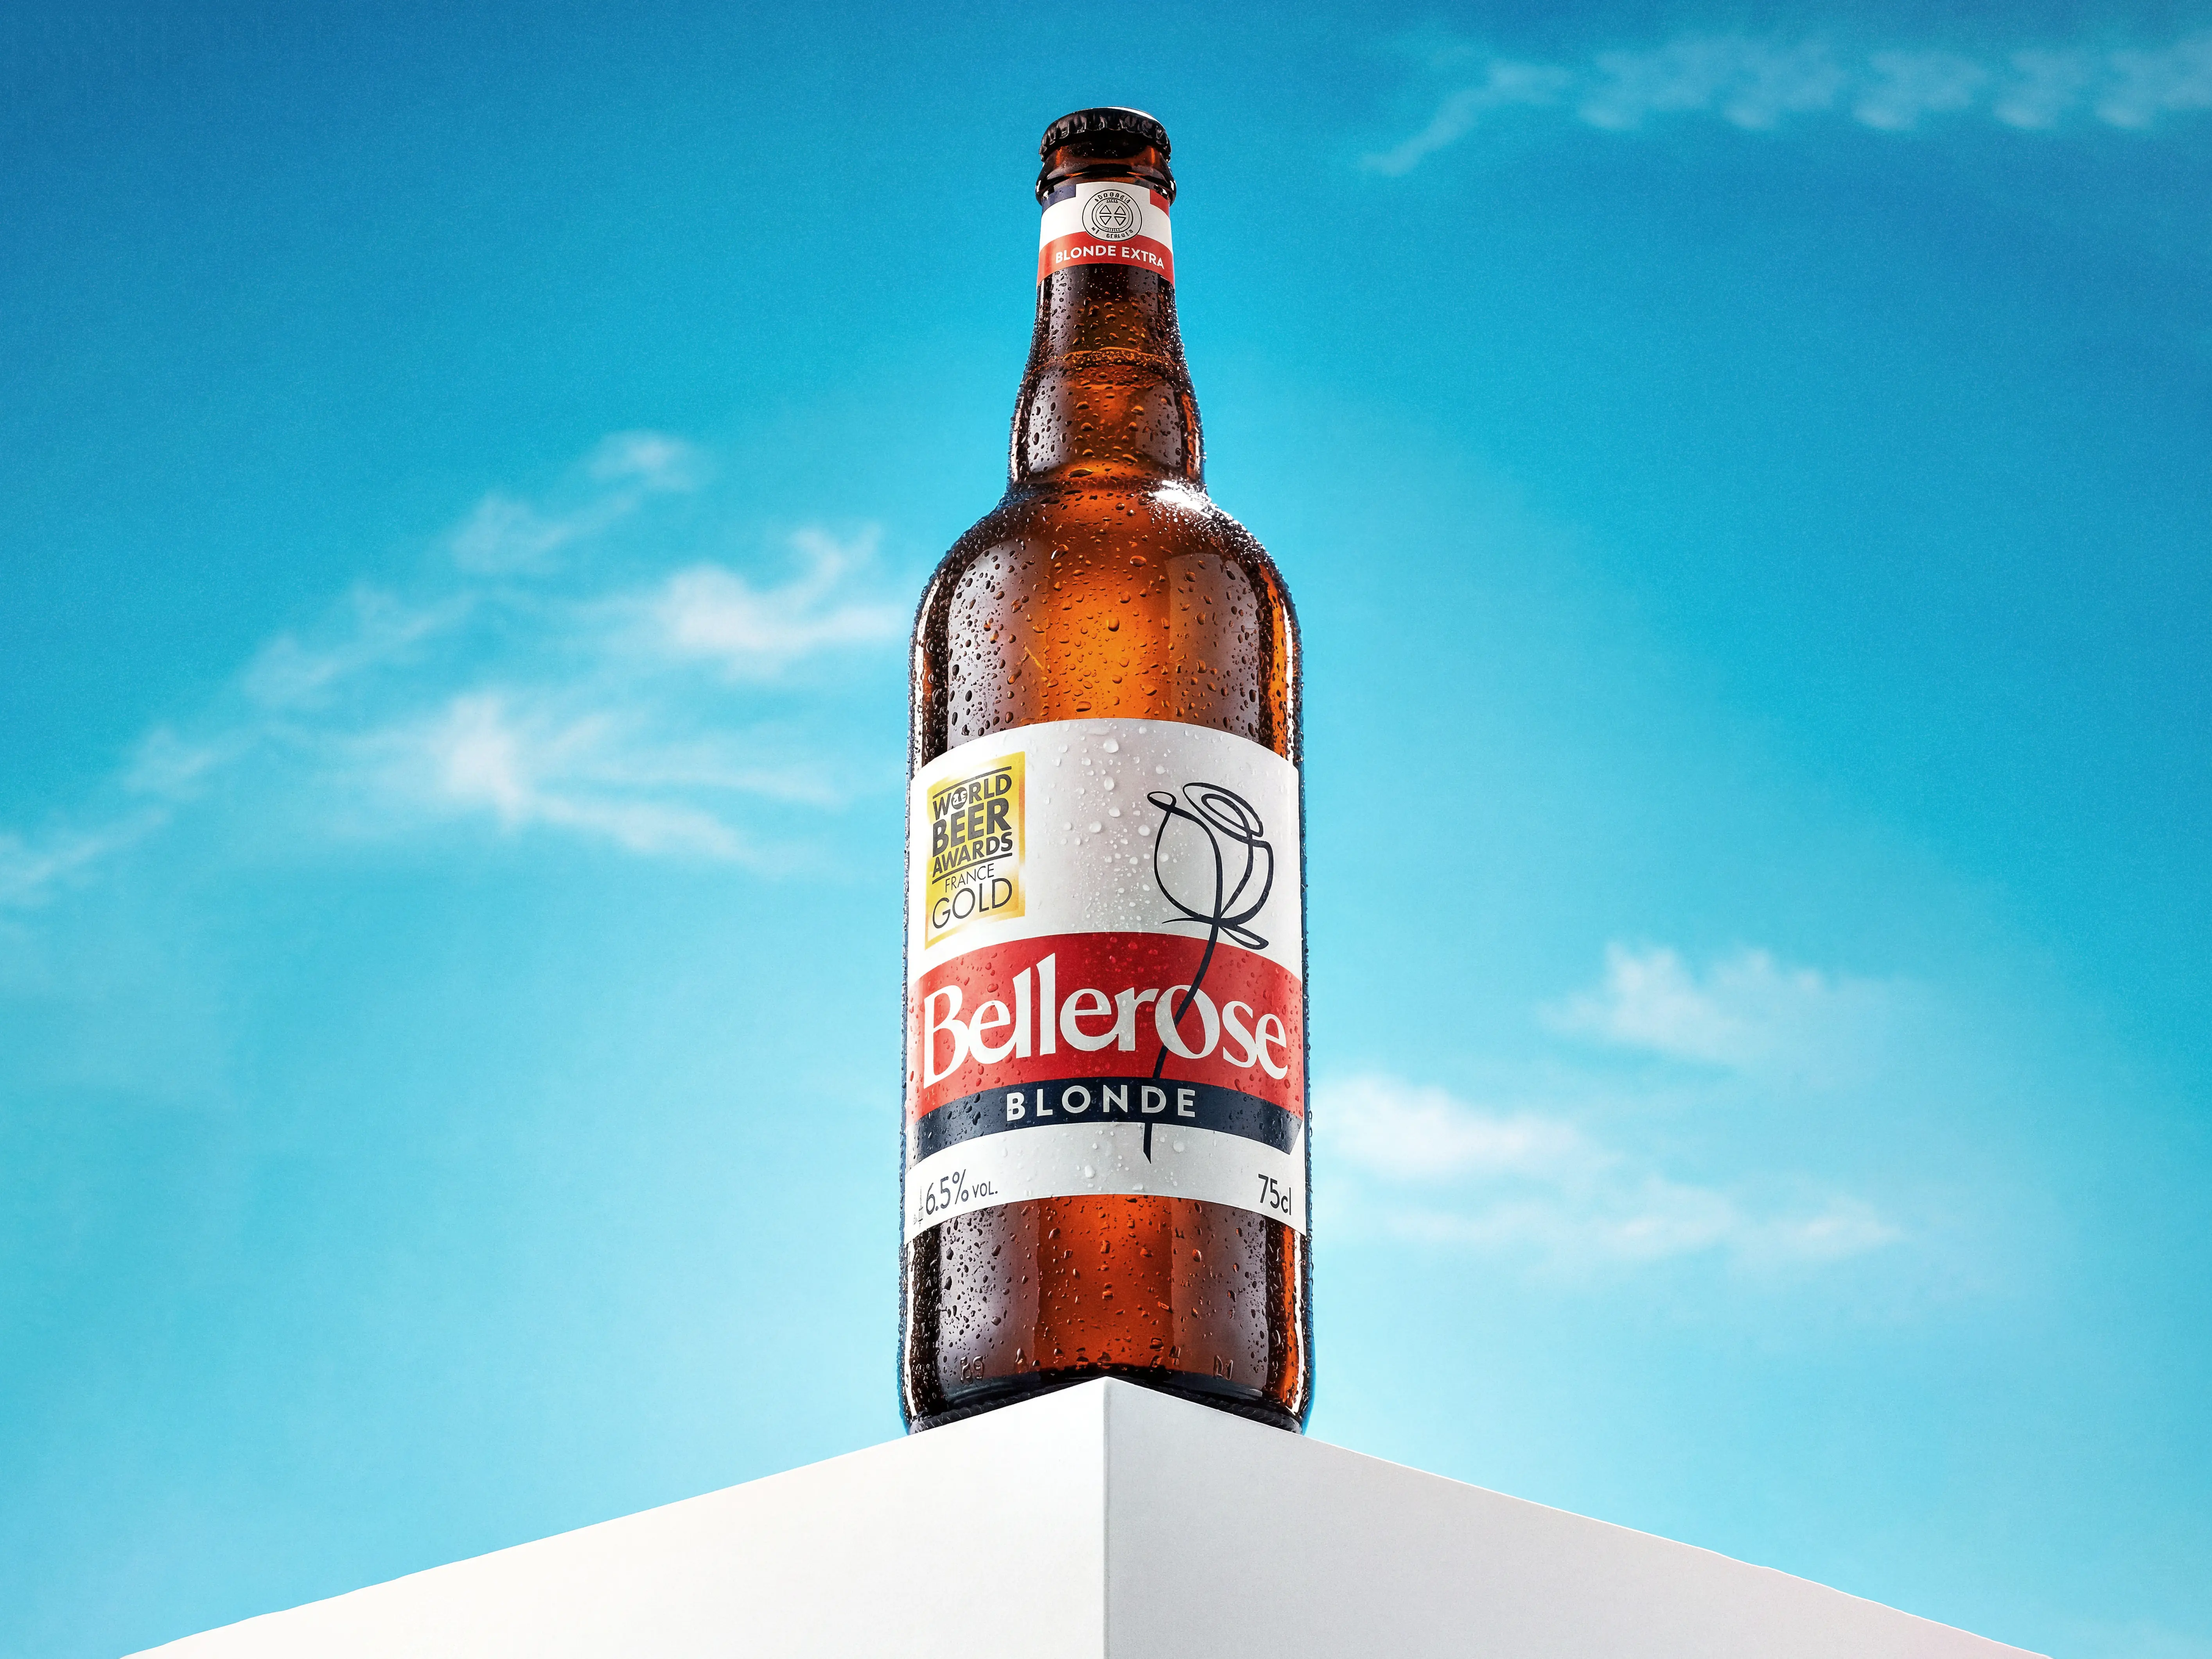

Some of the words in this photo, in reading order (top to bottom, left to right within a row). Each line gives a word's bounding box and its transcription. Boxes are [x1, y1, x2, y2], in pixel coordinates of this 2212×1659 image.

[1056, 245, 1117, 264] BLONDE
[1121, 247, 1165, 270] EXTRA
[932, 774, 1012, 821] WORLD
[932, 798, 1012, 857] BEER
[932, 831, 1013, 878] AWARDS
[945, 863, 995, 893] FRANCE
[932, 878, 1013, 929] GOLD
[923, 952, 1289, 1089] Bellerose
[1006, 1084, 1196, 1122] BLONDE
[926, 1169, 969, 1215] 6.5%
[972, 1181, 998, 1198] VOL.
[1258, 1173, 1291, 1216] 75cl
